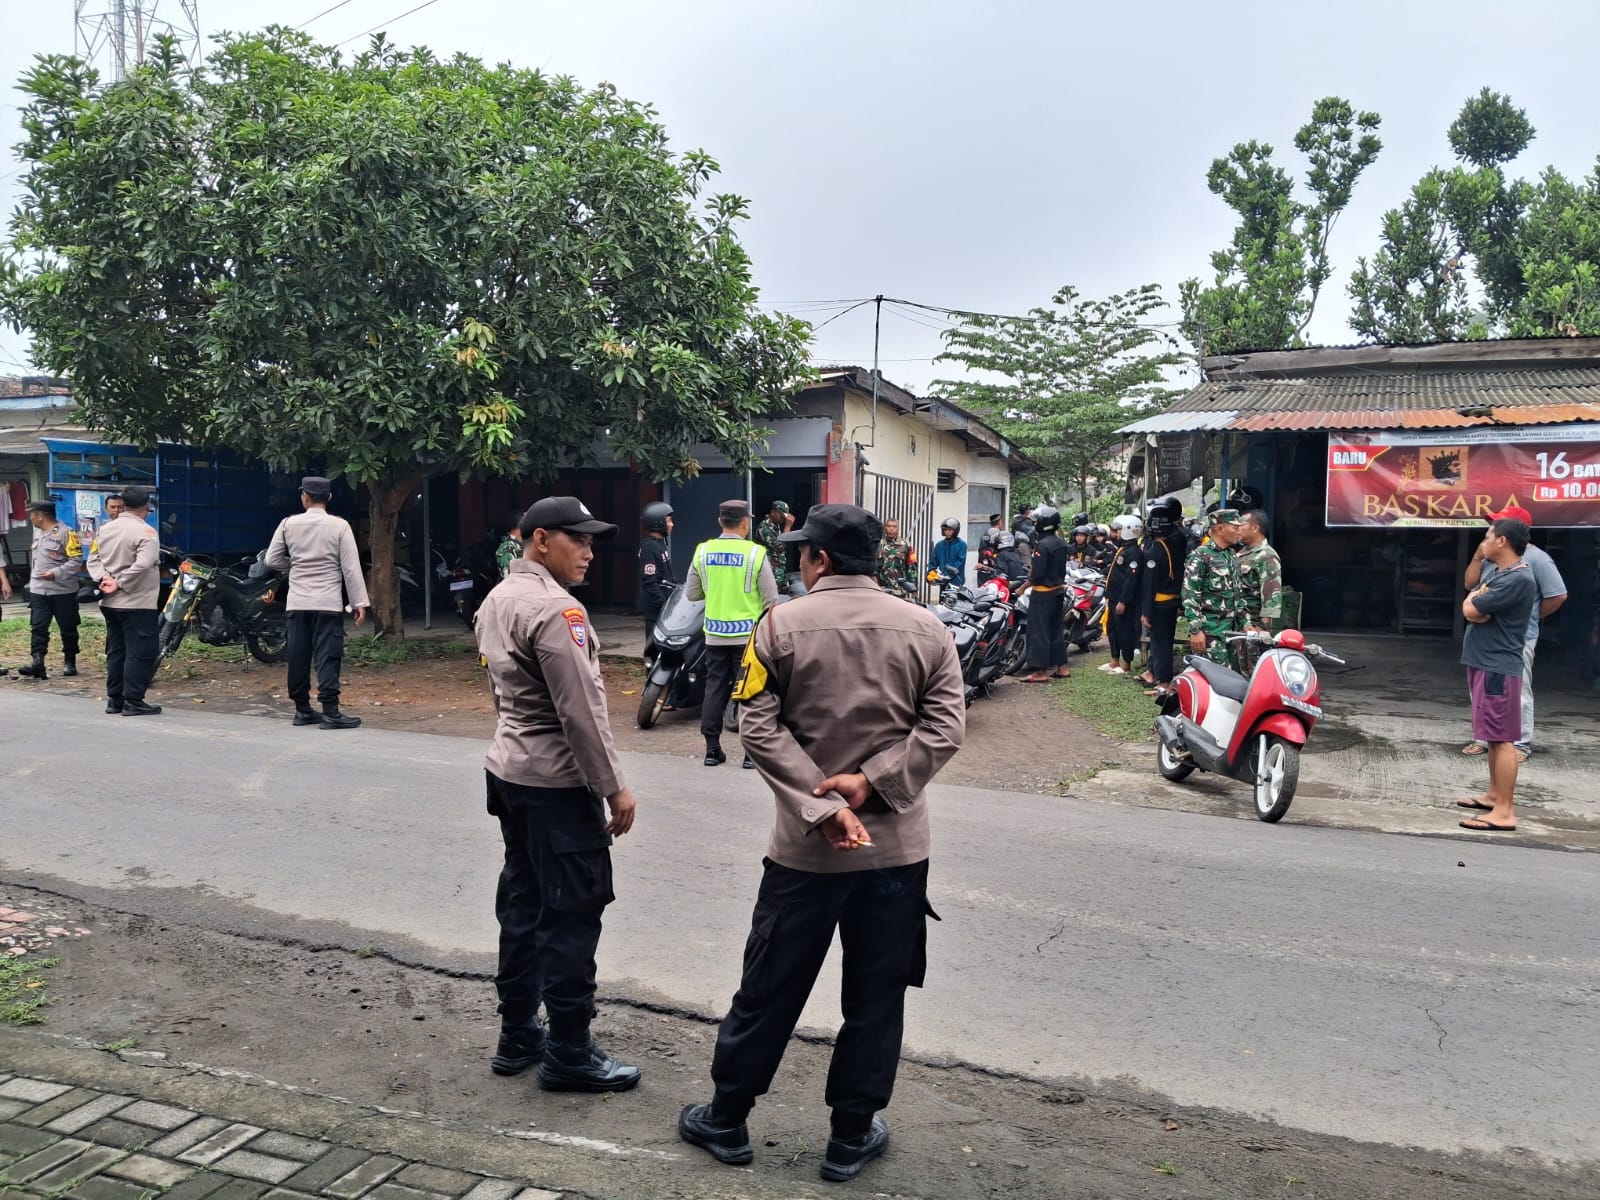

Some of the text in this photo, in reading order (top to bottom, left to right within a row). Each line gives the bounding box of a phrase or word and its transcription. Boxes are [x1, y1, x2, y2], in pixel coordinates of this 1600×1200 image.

[1333, 452, 1367, 465] BARU
[1536, 451, 1570, 479] 16
[1541, 482, 1600, 498] Rp 10,0
[1363, 493, 1522, 516] BASKARA
[707, 553, 743, 565] POLISI
